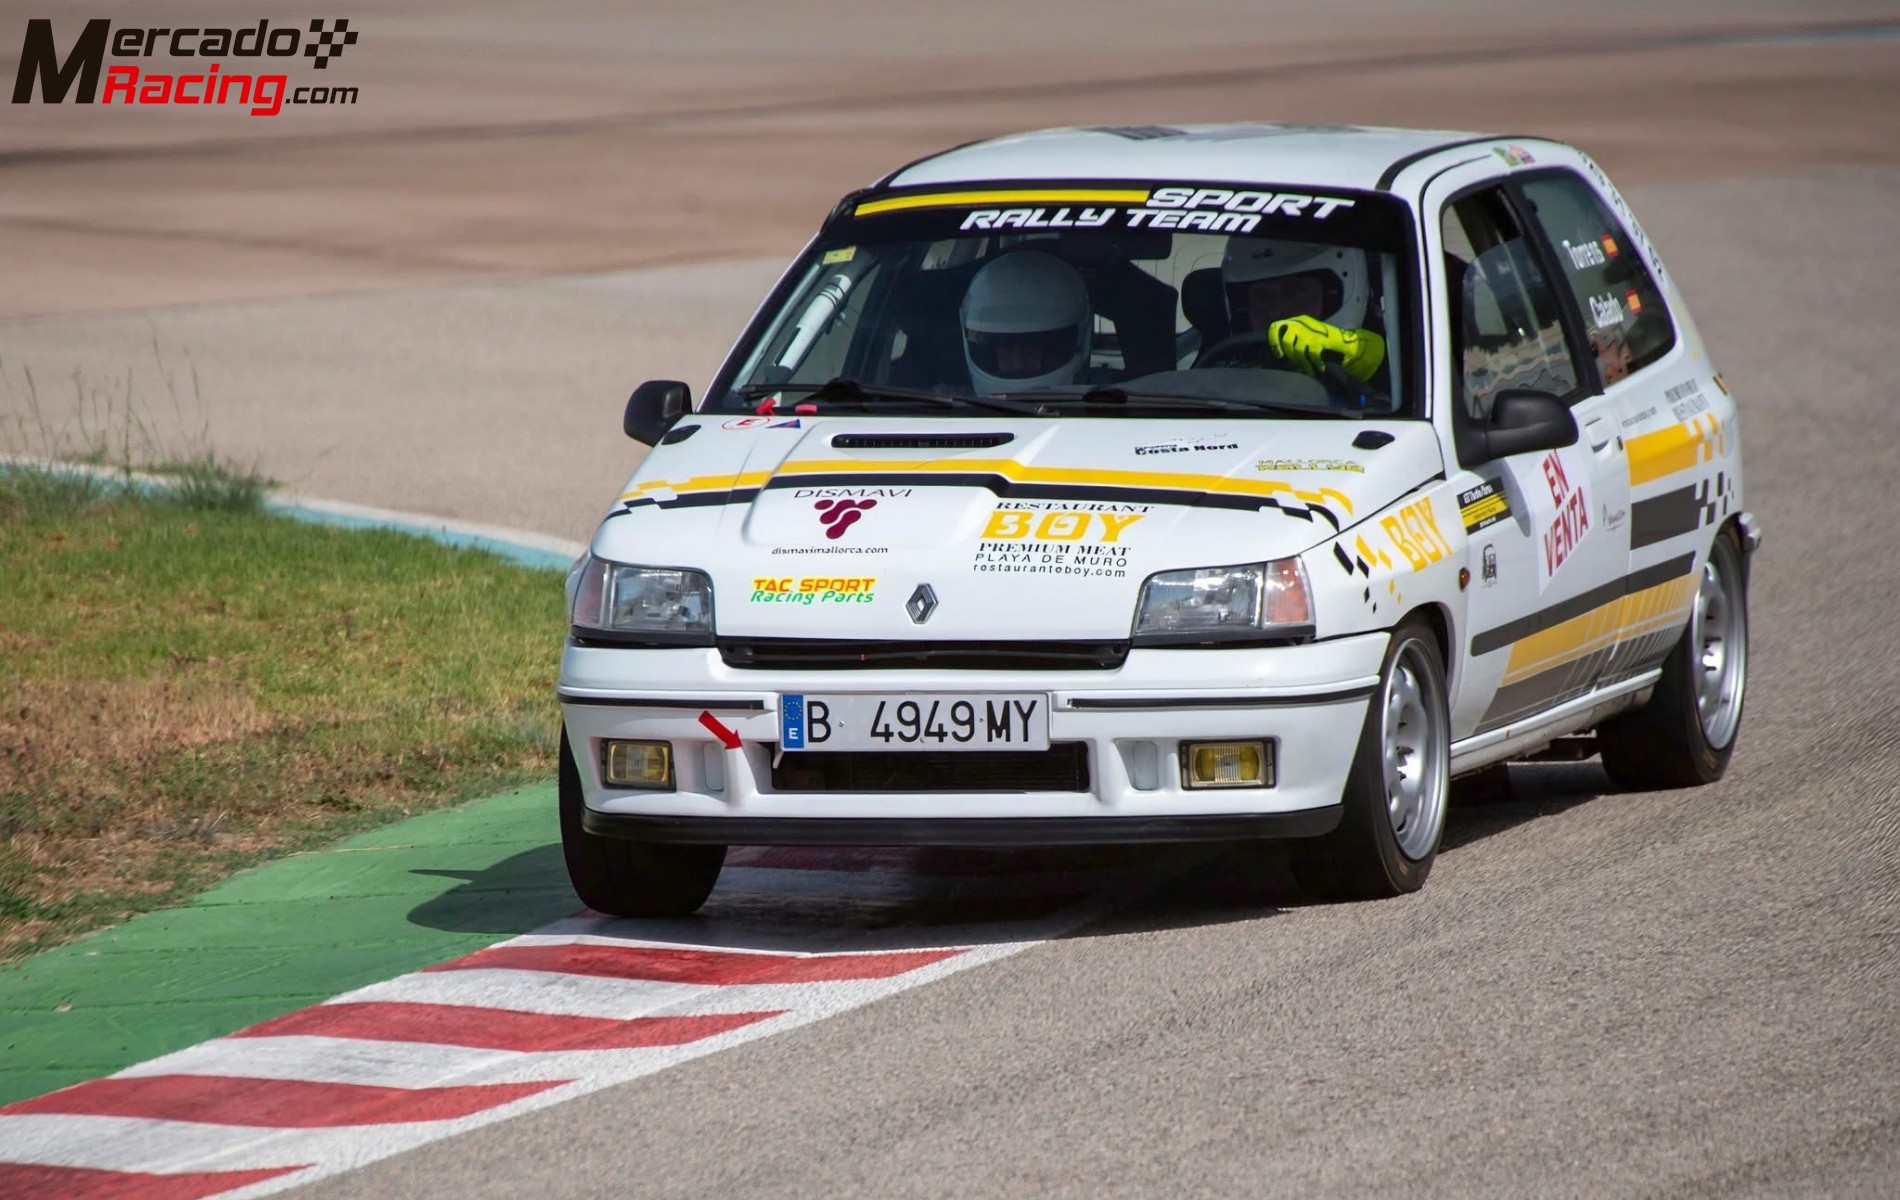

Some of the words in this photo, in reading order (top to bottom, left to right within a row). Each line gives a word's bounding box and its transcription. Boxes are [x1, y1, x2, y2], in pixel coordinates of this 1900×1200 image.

[1147, 187, 1355, 219] SPORT
[959, 208, 1116, 231] RALLY
[1126, 208, 1262, 233] TEAM
[1194, 443, 1239, 451] Nord
[1543, 449, 1569, 509] EN
[794, 488, 912, 498] DISMAVI
[996, 502, 1154, 513] RESTAURANT
[980, 510, 1145, 542] BOY
[1544, 486, 1588, 577] VENTA
[1379, 496, 1453, 572] BOY
[772, 546, 888, 555] dismavimallorca.com
[979, 542, 1070, 554] PREMIUM
[1077, 545, 1131, 556] MEAT
[975, 553, 1031, 562] PLAYA
[1041, 555, 1064, 563] DE
[1074, 556, 1127, 566] MURO
[974, 563, 1125, 577] restauranteboy.com
[753, 577, 793, 593] TAC
[799, 577, 876, 593] SPORT
[751, 590, 815, 605] Racing
[821, 590, 874, 603] Parts
[806, 700, 832, 743] B
[870, 700, 976, 743] 4949
[986, 700, 1038, 743] MY
[789, 727, 799, 740] E
